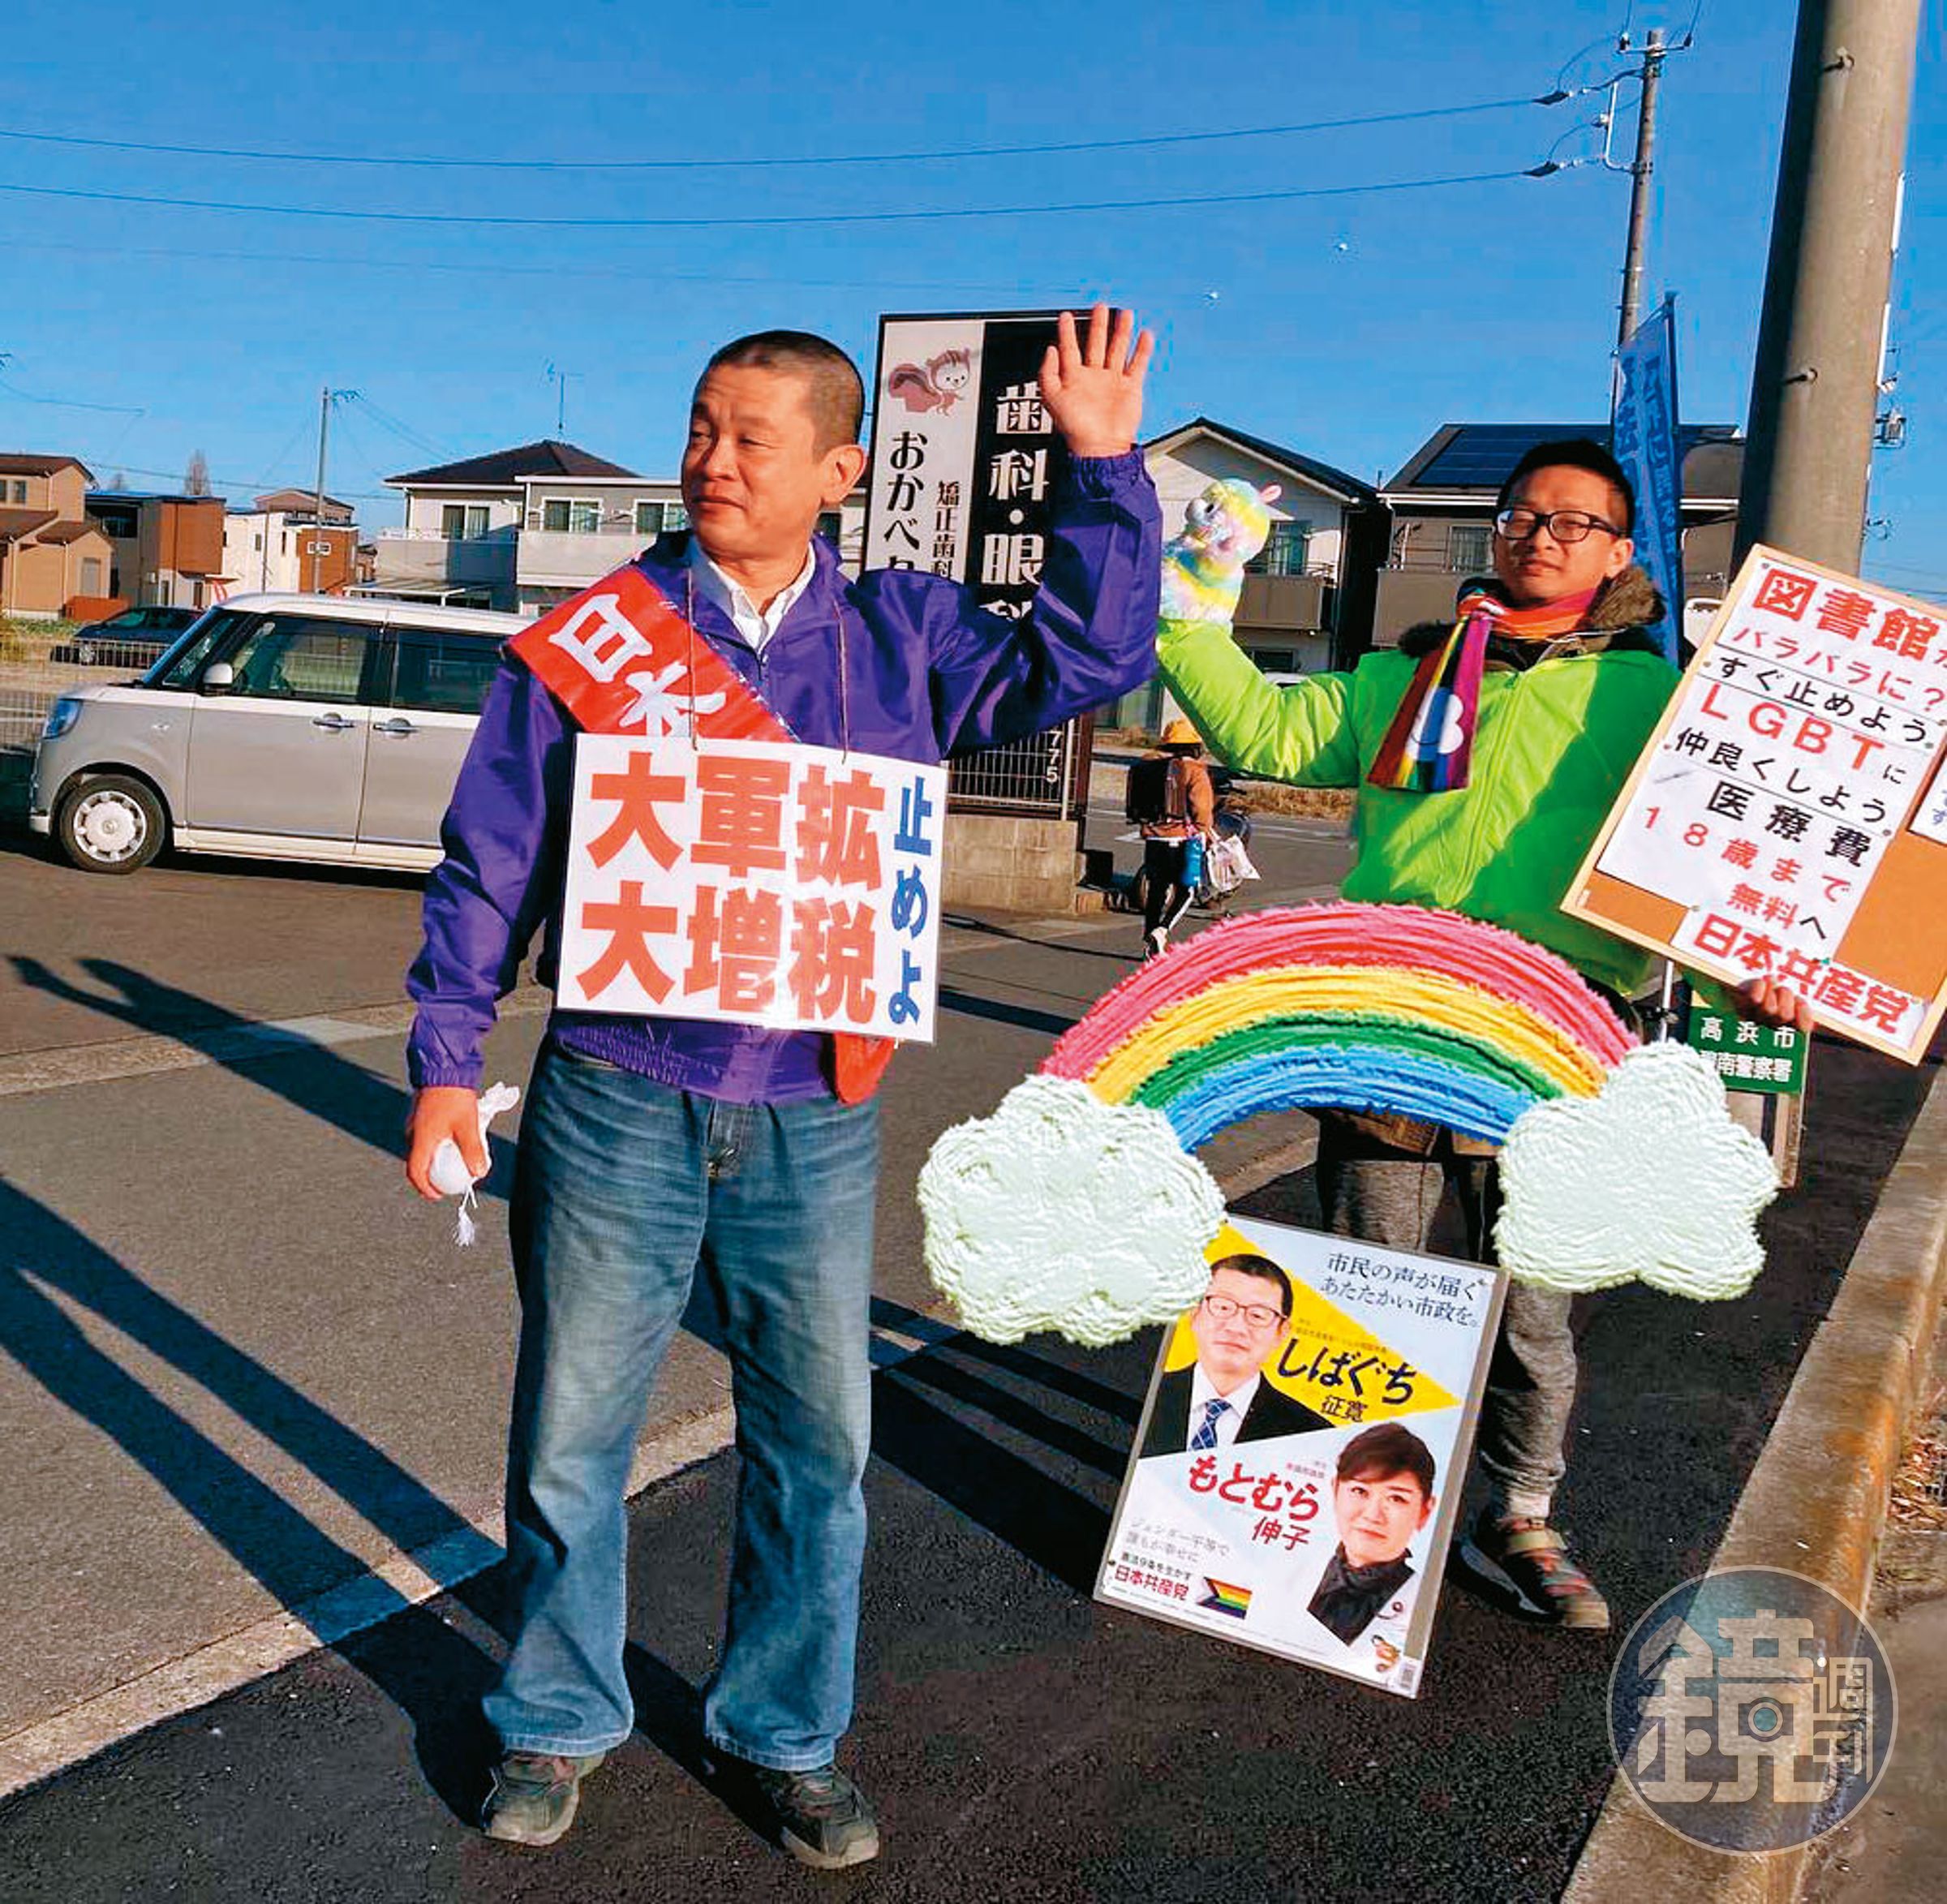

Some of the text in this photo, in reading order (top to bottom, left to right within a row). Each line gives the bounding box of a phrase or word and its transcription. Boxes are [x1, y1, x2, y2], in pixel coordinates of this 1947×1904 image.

[1720, 657, 1927, 742] すぐ止めよう
[1733, 628, 1945, 712] バラバラに？
[1700, 681, 1906, 784] LGBTに
[1675, 727, 1886, 823] 仲良くしよう
[586, 751, 885, 892] 大軍拡
[1644, 806, 1851, 902] 18歳まで
[1706, 780, 1871, 867] 医療費
[888, 776, 932, 1025] 止めよ
[1726, 882, 1826, 940] 無料へ
[576, 881, 877, 1025] 大増税
[1693, 913, 1910, 1034] 日本共産党
[1700, 1016, 1796, 1048] 高浜市
[1321, 1276, 1480, 1328] あたたかい市政を。
[1327, 1253, 1476, 1301] 市民の声が届く
[1277, 1338, 1417, 1405] しばぐち
[1189, 1455, 1319, 1521] もとむら
[1252, 1516, 1311, 1550] 伸子
[1115, 1564, 1189, 1601] 日本共産党
